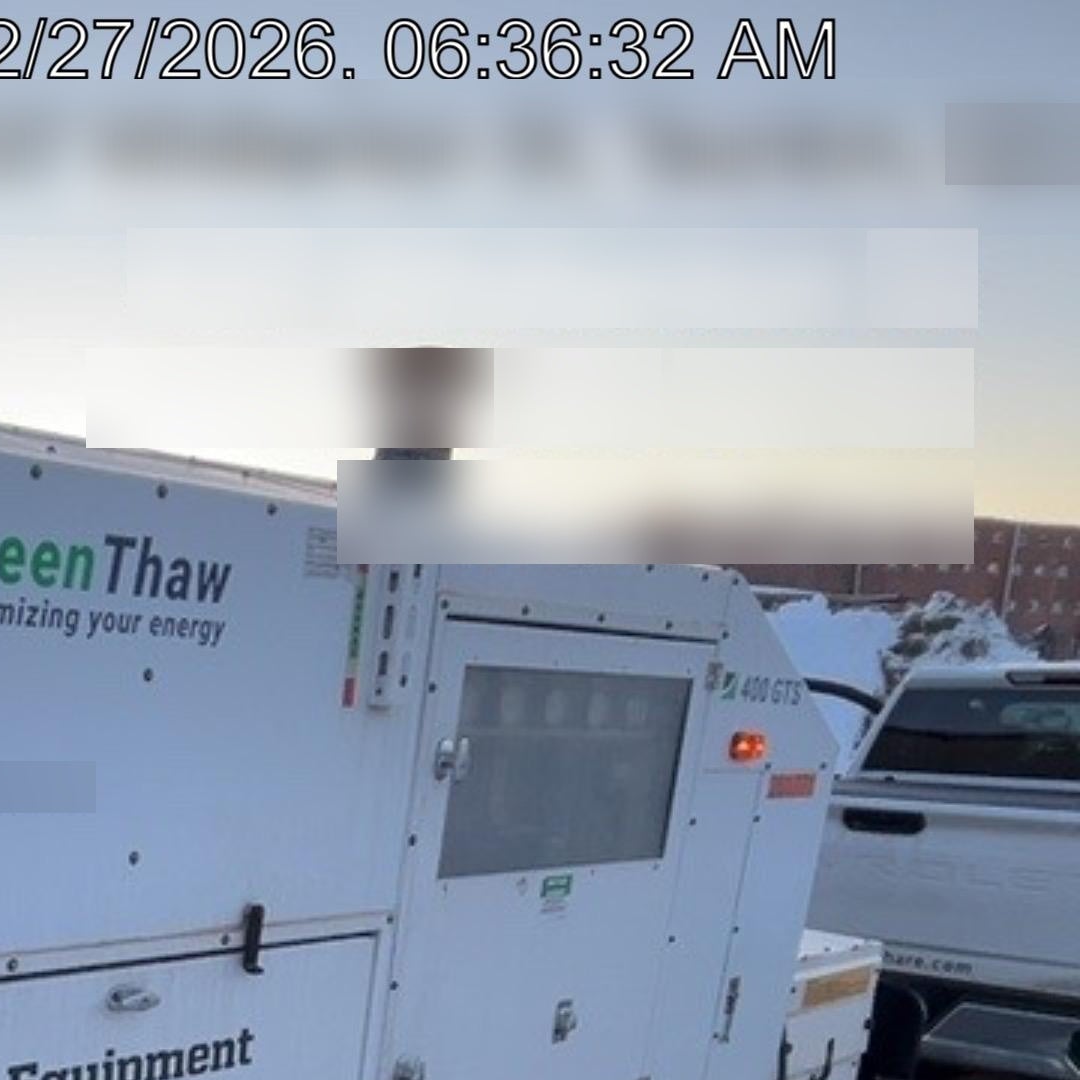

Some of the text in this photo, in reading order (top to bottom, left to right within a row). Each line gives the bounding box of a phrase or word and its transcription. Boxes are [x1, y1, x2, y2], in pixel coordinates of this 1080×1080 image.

[87, 610, 142, 640] your
[149, 613, 226, 647] energy
[742, 675, 801, 706] 400 GTS
